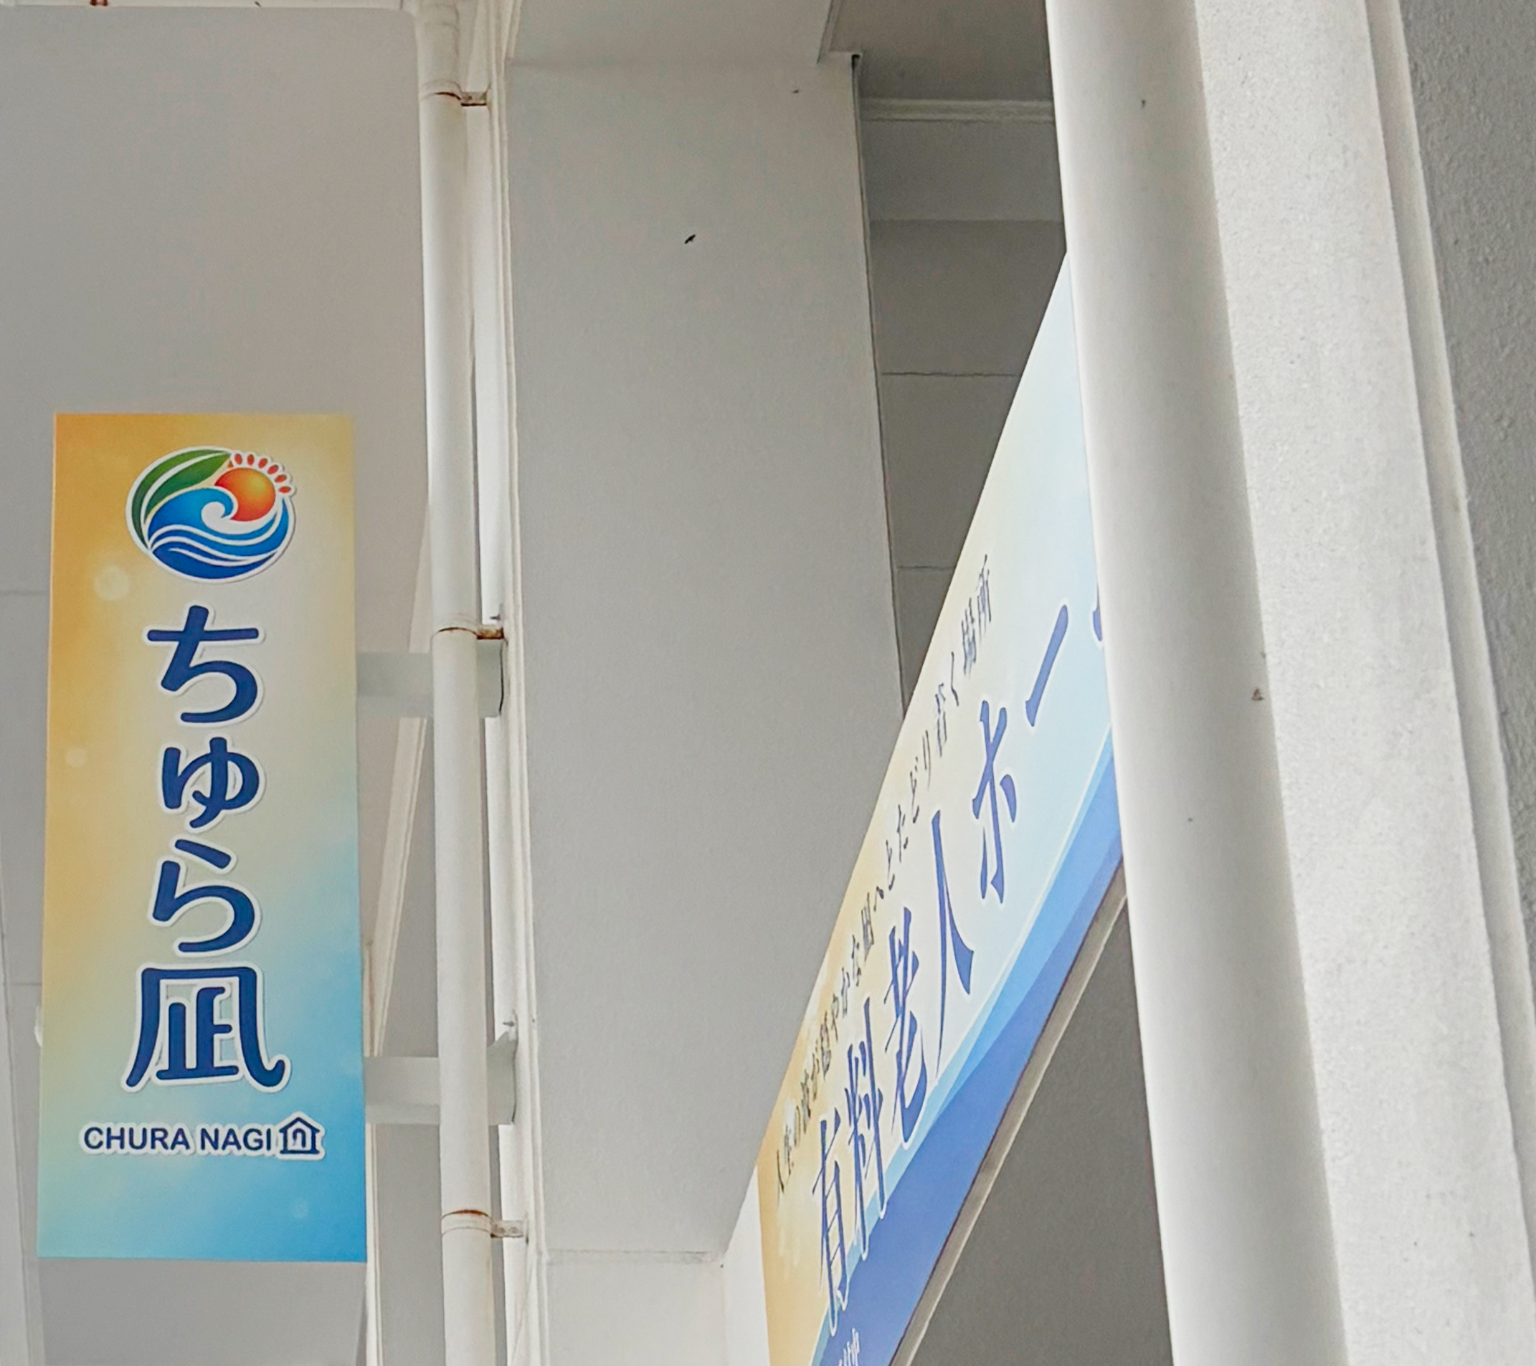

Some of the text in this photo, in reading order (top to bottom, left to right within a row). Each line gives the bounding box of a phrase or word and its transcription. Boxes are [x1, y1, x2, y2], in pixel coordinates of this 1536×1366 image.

[125, 604, 286, 1089] ちゅら凪
[809, 580, 1103, 1327] 有料老人ホー
[83, 1126, 272, 1152] CHURA NAGI
